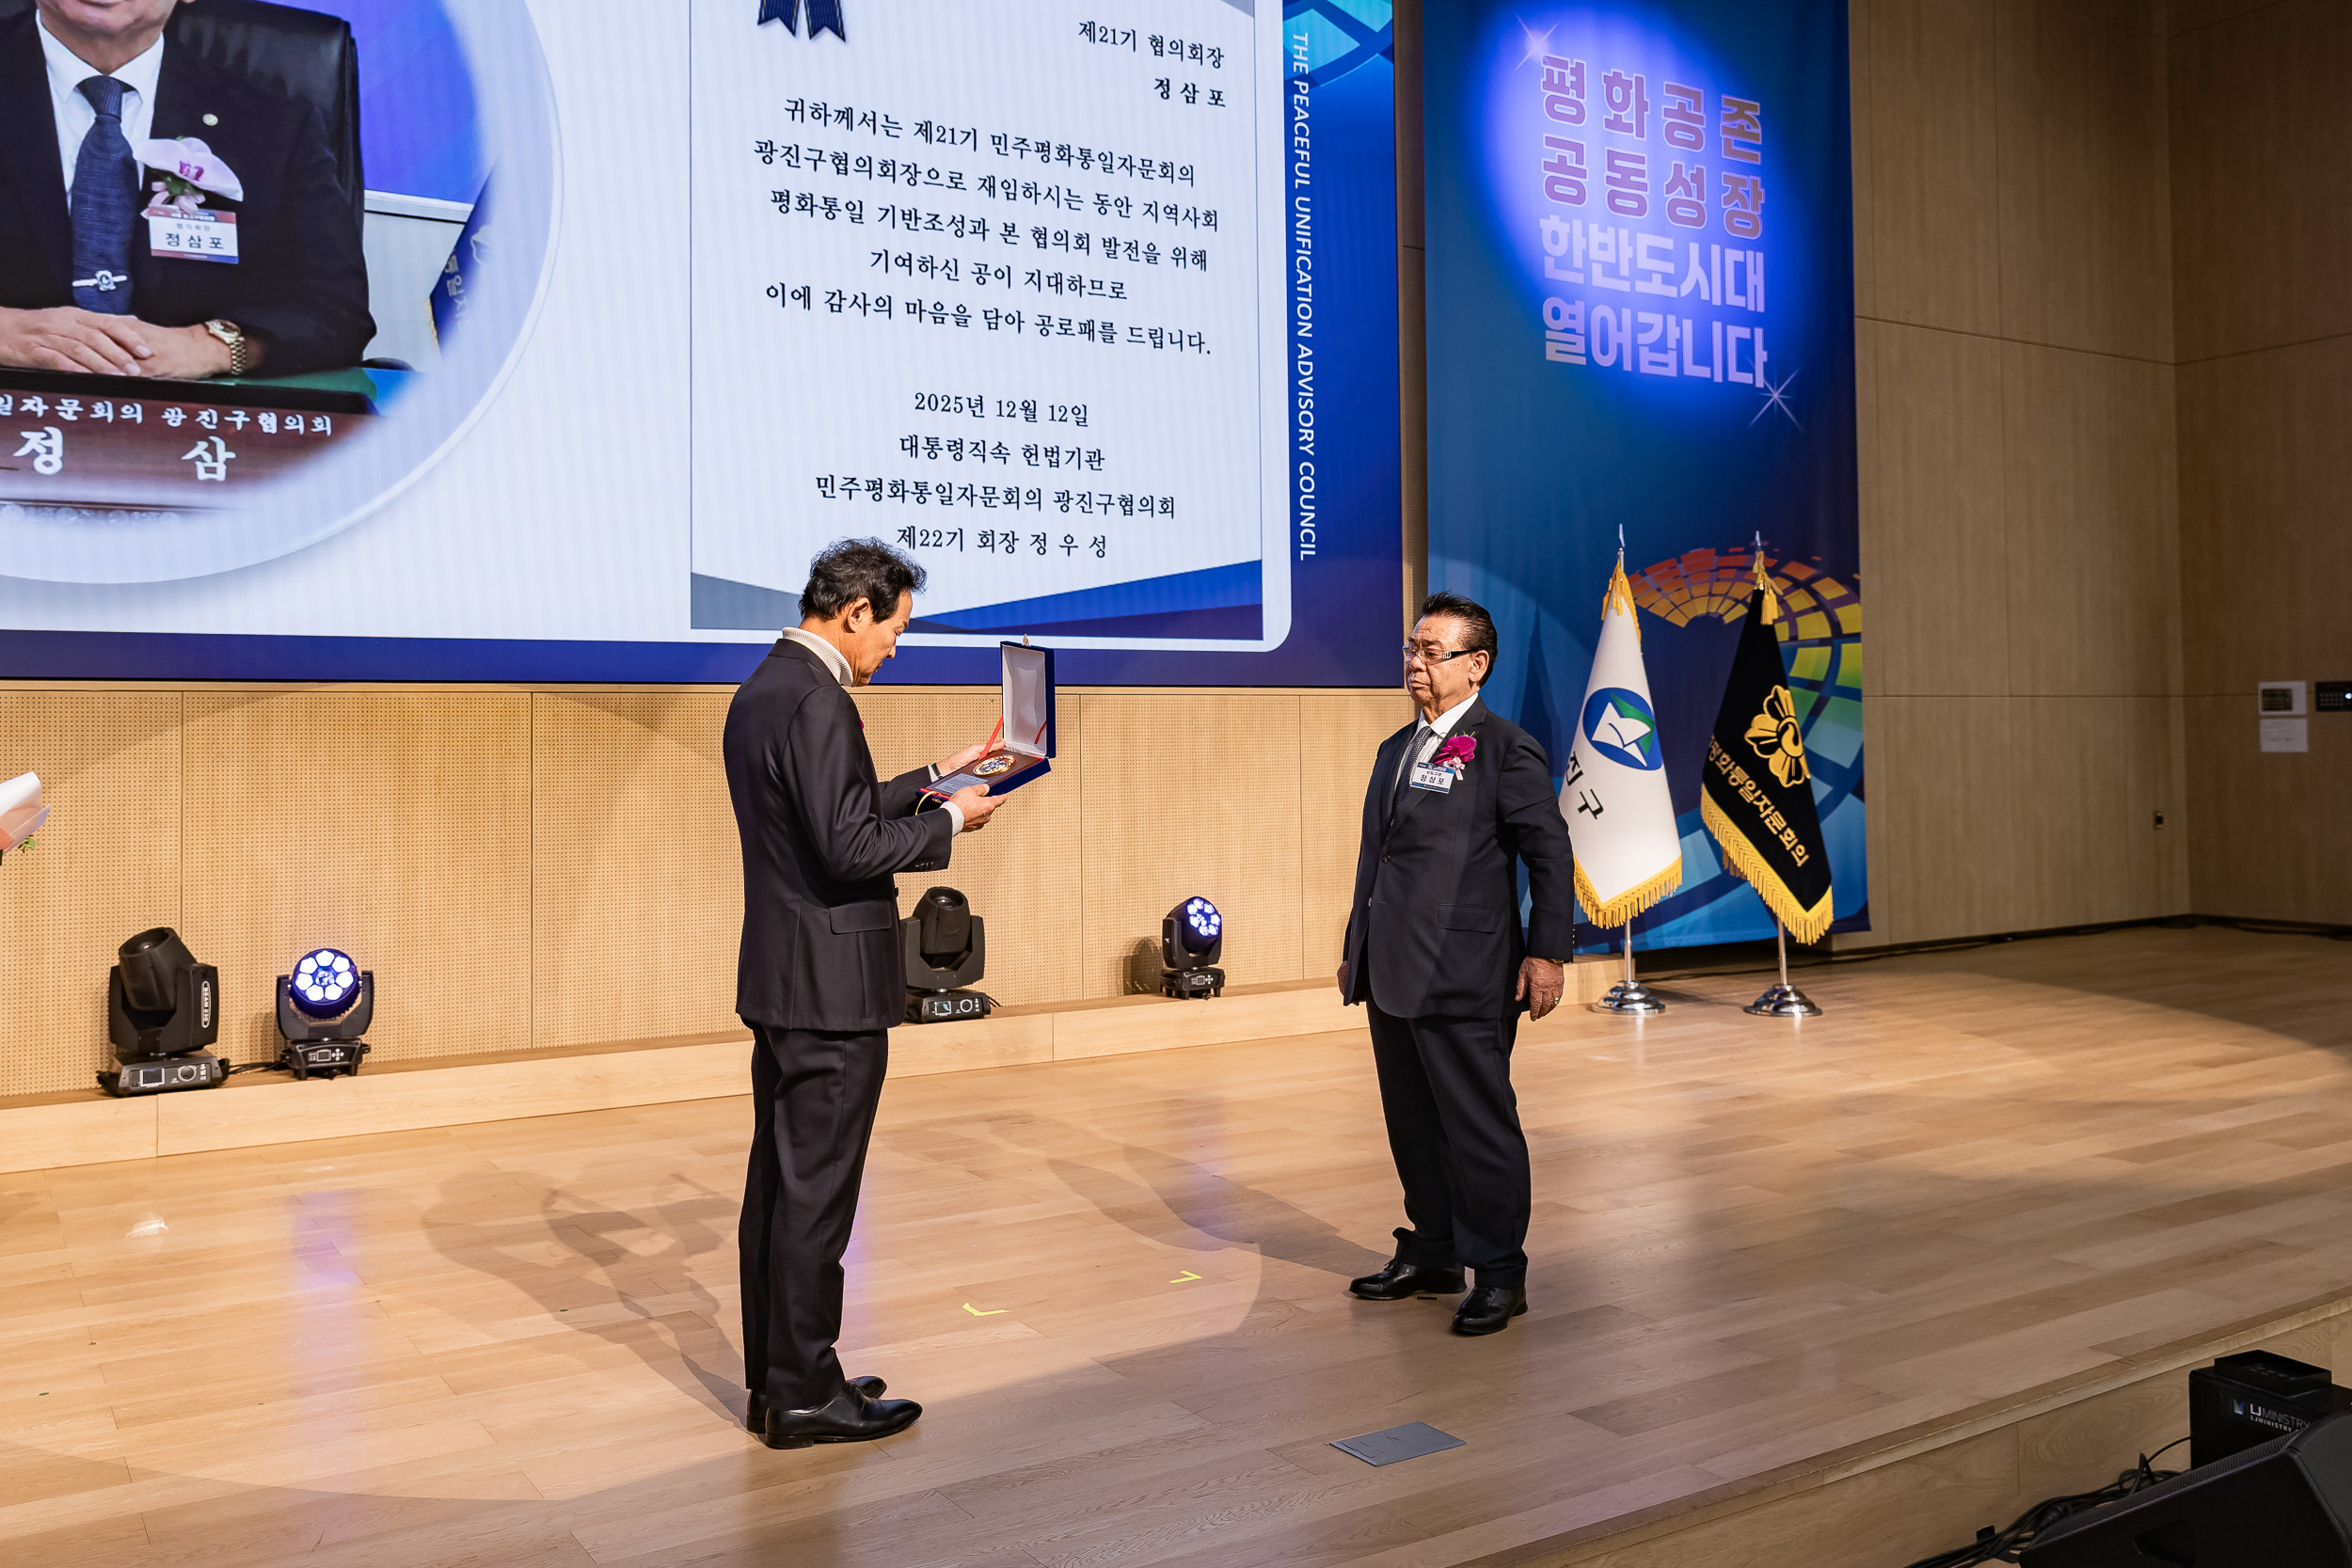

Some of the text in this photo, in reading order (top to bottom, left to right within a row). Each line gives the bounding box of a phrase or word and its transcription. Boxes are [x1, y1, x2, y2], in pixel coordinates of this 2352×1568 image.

[1078, 20, 1225, 70] 제21기 협의회장
[784, 97, 1194, 188] 귀하께서는 제21기 민주평화통일자문회의
[754, 139, 1217, 233] 광진구협의회장으로 재임하시는 동안 지역사회
[771, 188, 1207, 273] 평화통일 기반조성과 본 협의회 발전을 위해
[1539, 214, 1766, 313] 한반도시대
[870, 248, 1128, 300] 기여하신 공이 지대하므로
[1292, 32, 1316, 562] THE PEACEFUL UNIFICATION ADVISORY COUNCIL
[766, 281, 1211, 356] 이에 감사의 마음을 담아 공로패를 드립니다.
[1542, 296, 1769, 388] 열어갑니다
[161, 406, 334, 437] 광진구협의회
[914, 391, 1089, 428] 2025년 12월 12일
[12, 426, 237, 483] 정 삼
[899, 434, 1105, 471] 대통령직속 헌법기관
[815, 474, 1174, 520] 민주평화통일자문회의 광진구협의회
[897, 525, 963, 553] 제22기
[977, 529, 1020, 555] 회장
[1708, 735, 1810, 868] 평화통일자문회의
